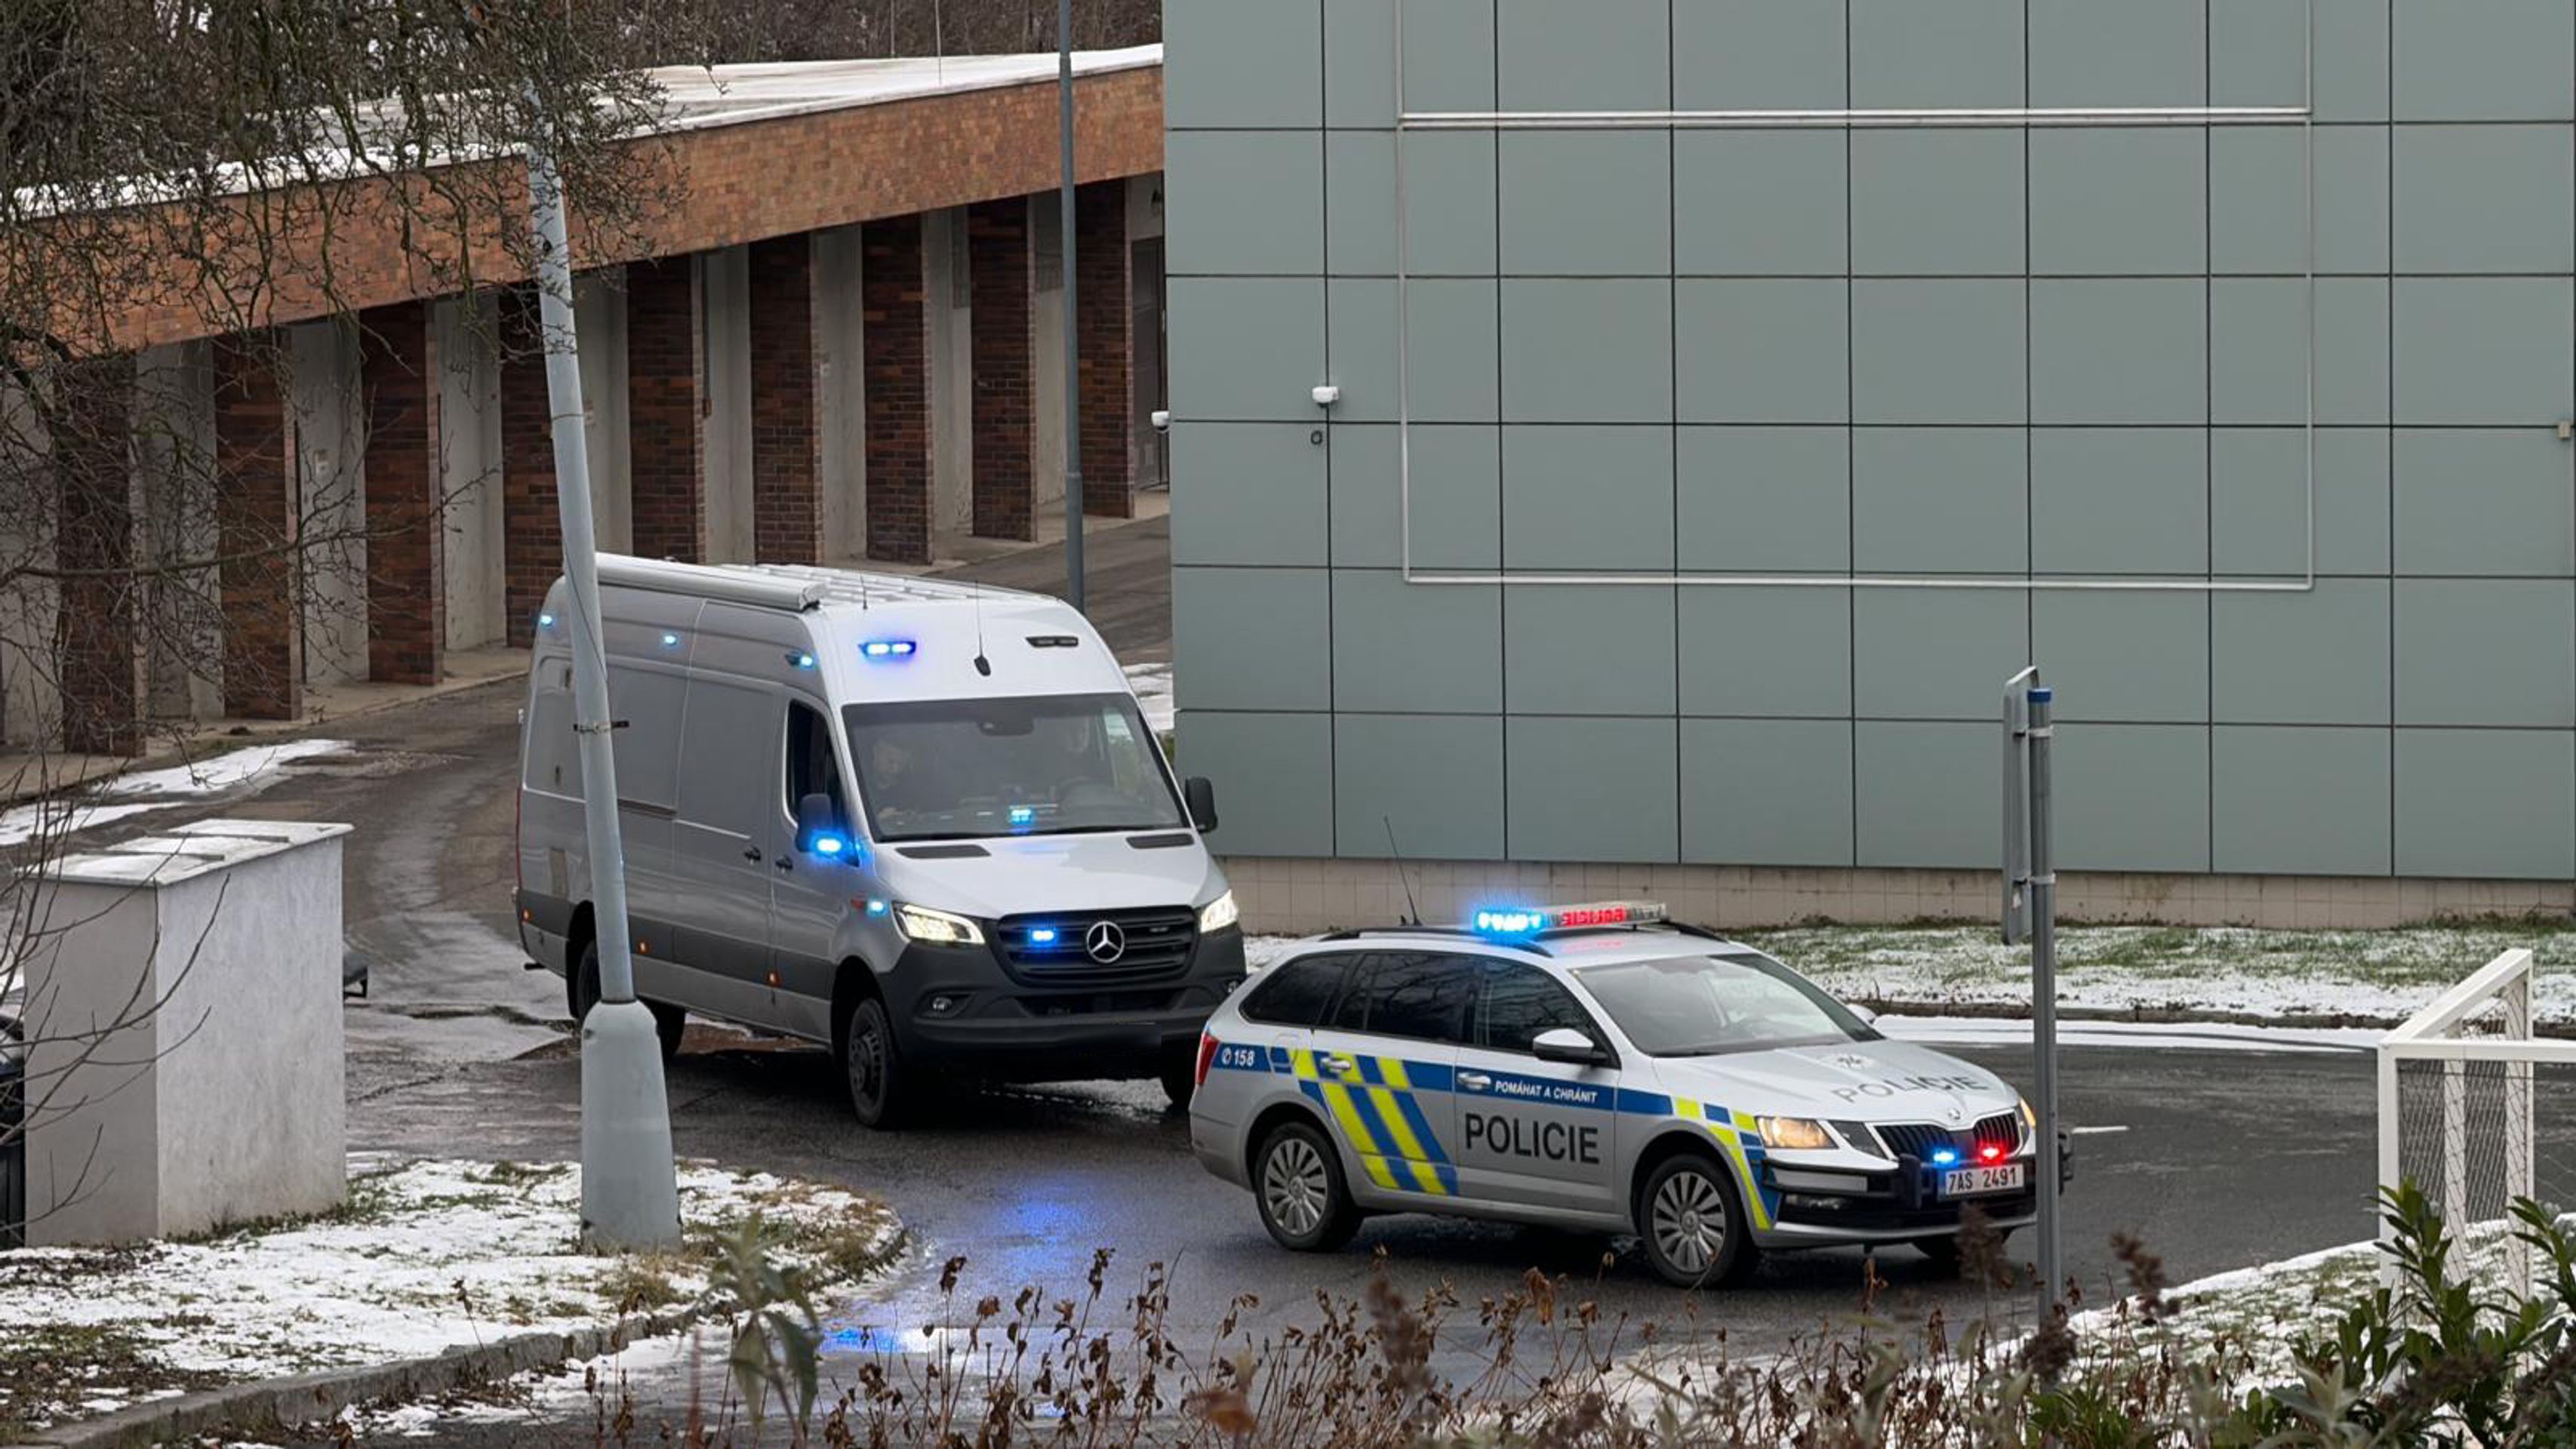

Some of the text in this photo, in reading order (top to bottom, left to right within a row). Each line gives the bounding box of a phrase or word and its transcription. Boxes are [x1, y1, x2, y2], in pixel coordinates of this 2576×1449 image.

[1234, 1049, 1255, 1067] 158
[1495, 1080, 1598, 1103] POMÁHAT A CHRÁNIT
[1832, 1076, 1989, 1103] POLICIE
[1465, 1112, 1600, 1164] POLICIE
[1949, 1167, 2016, 1192] 7AS 2491
